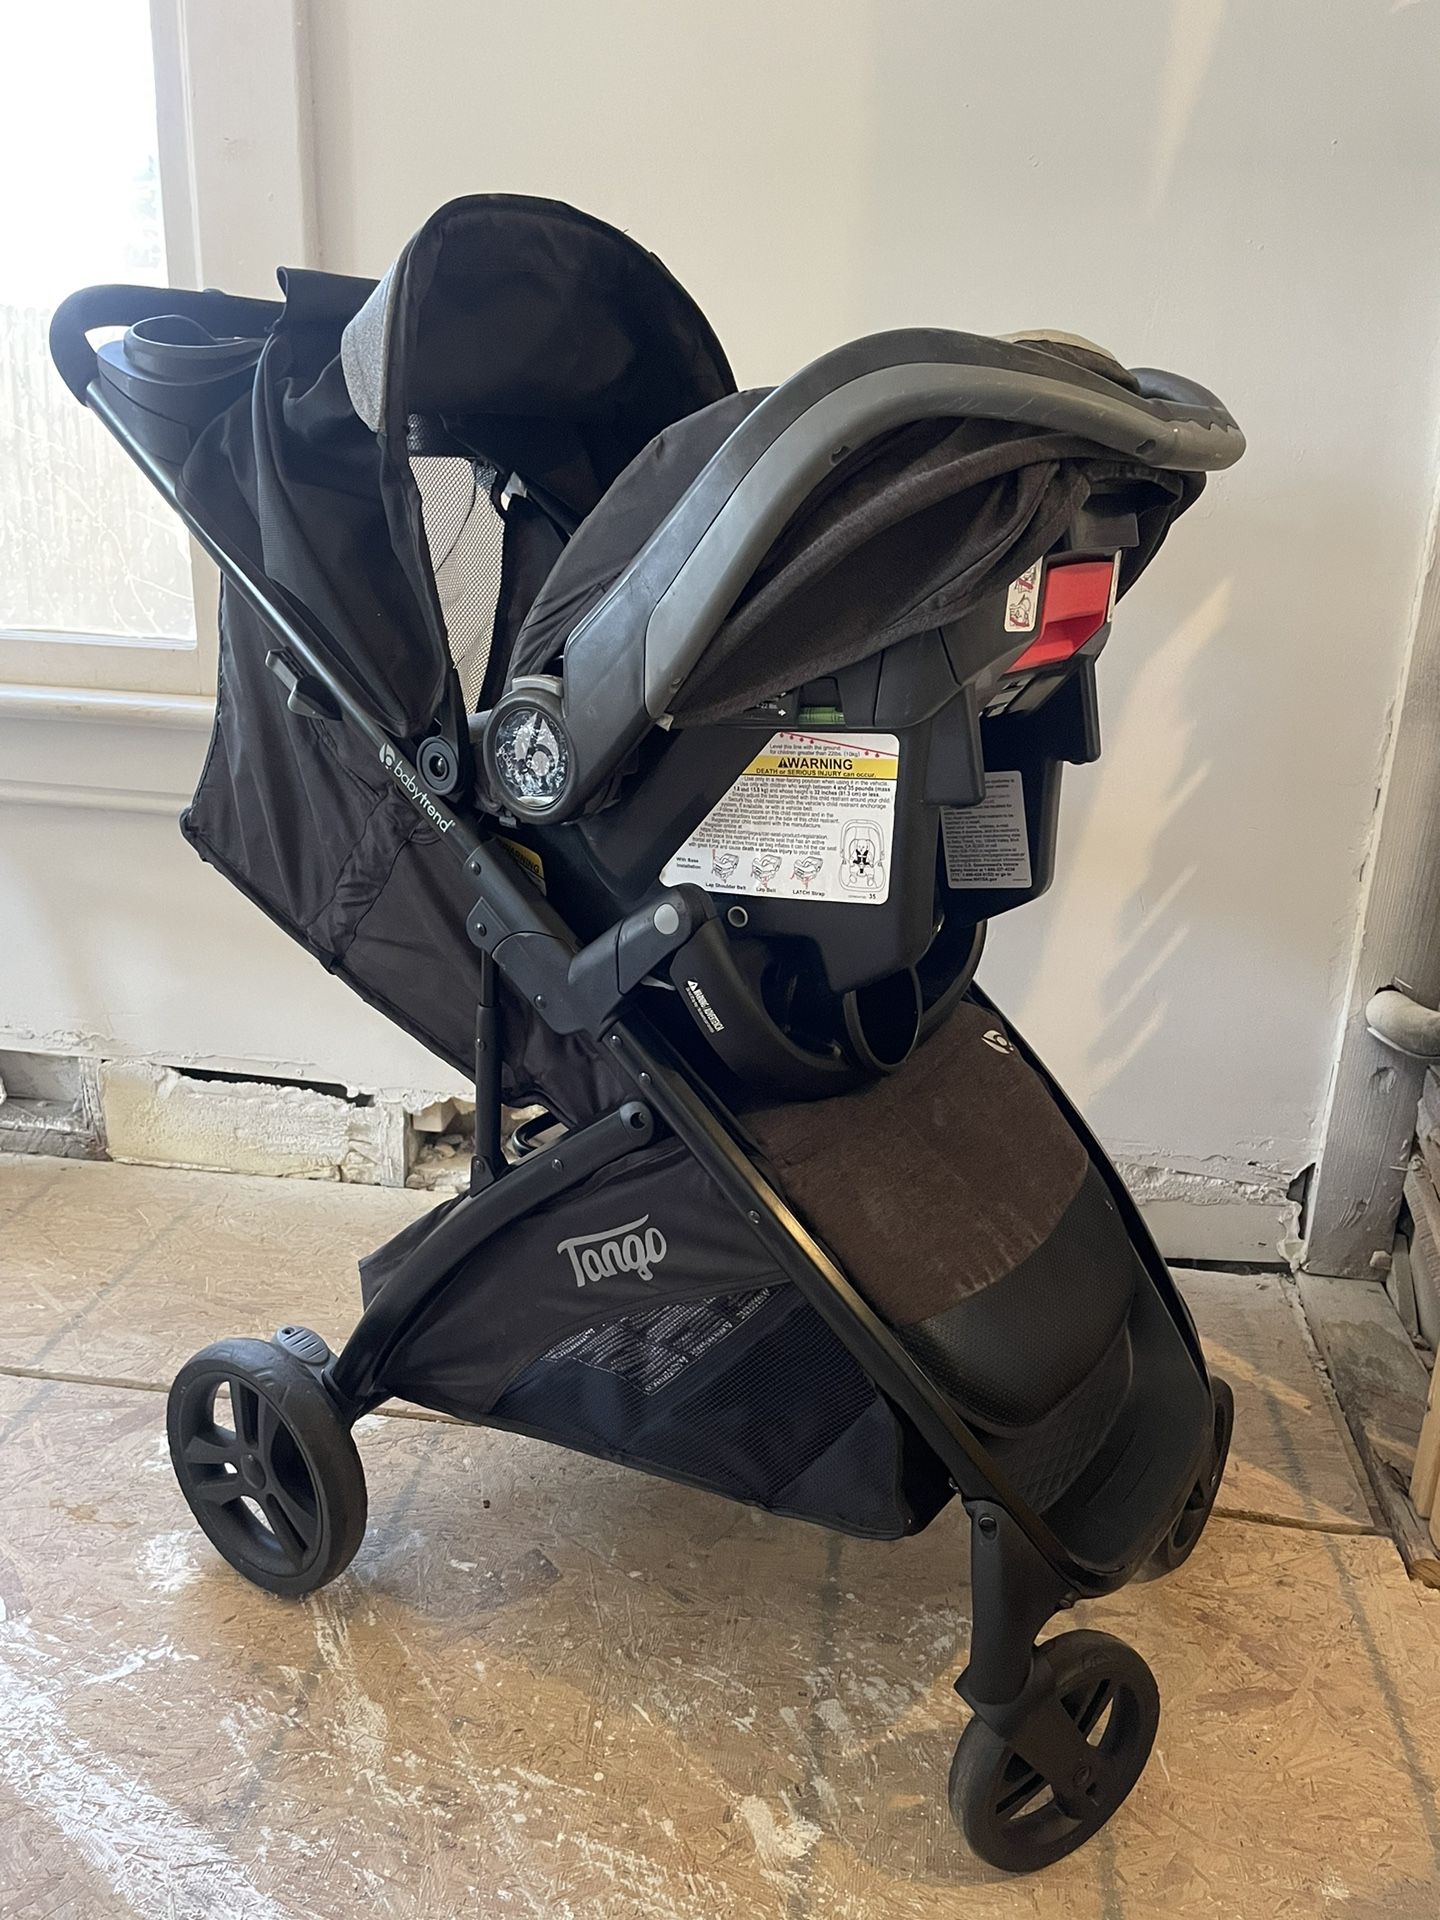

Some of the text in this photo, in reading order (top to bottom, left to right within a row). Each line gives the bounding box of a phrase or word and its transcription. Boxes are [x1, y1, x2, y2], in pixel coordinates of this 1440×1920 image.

[394, 760, 453, 832] babytrend
[788, 758, 853, 770] WARNING
[557, 1214, 666, 1287] Tango
